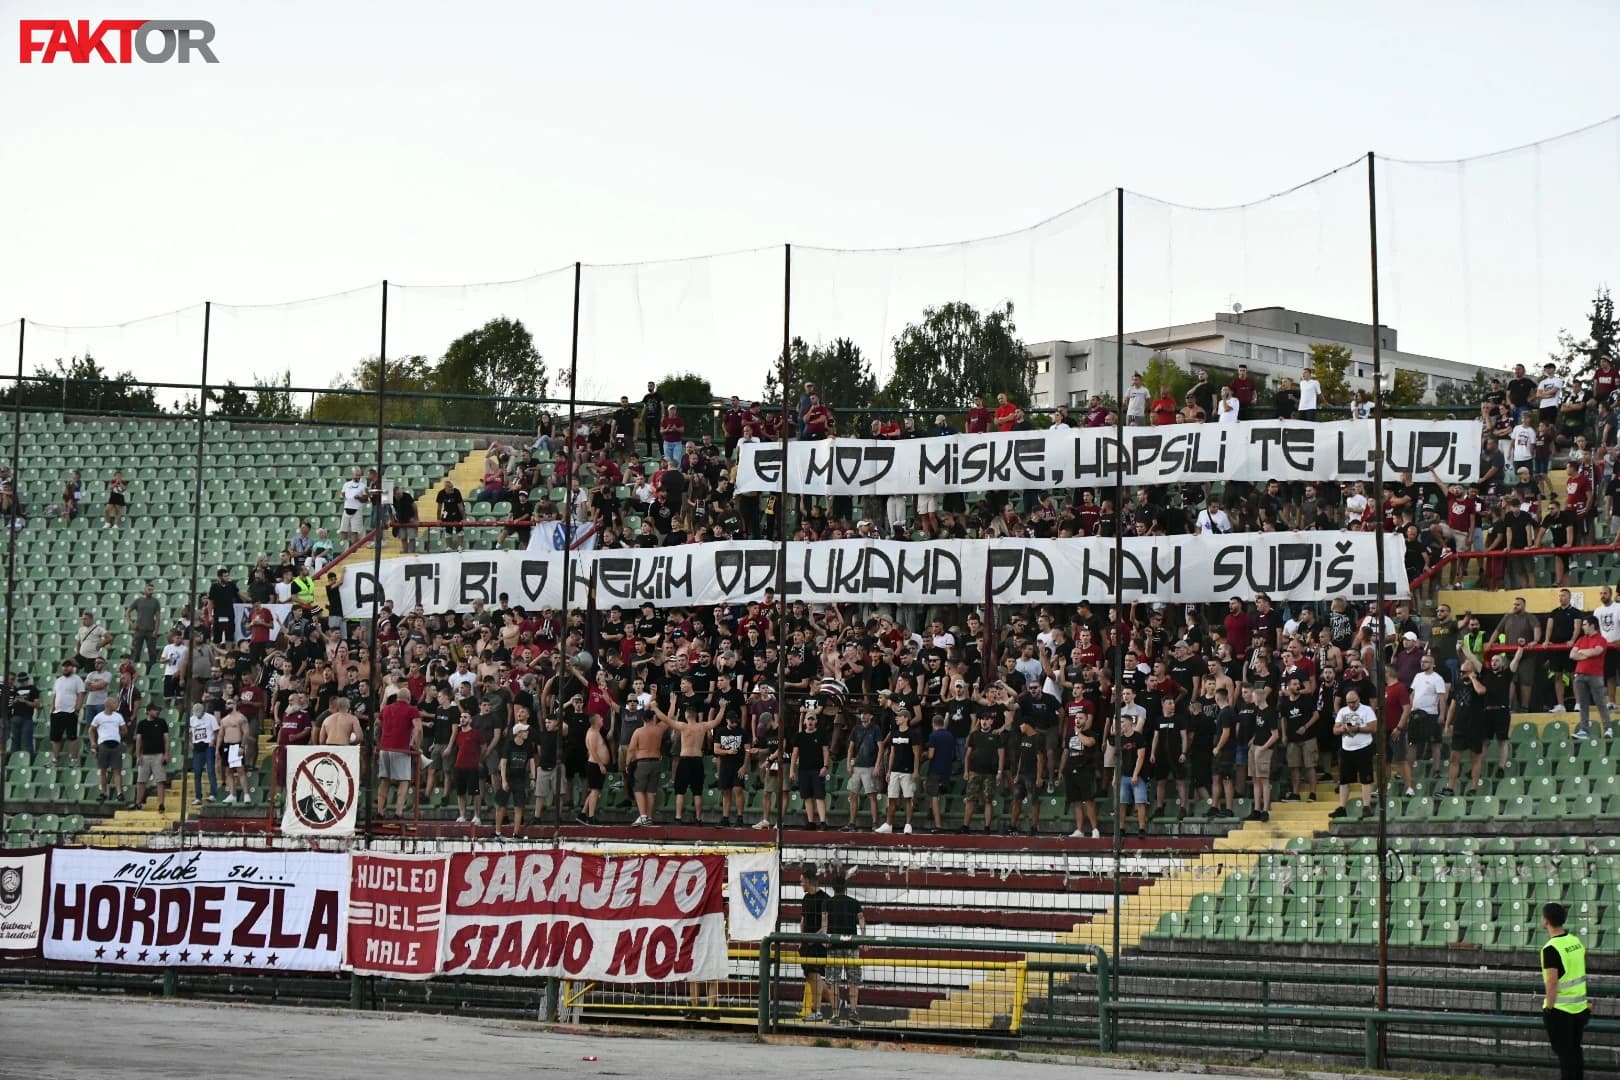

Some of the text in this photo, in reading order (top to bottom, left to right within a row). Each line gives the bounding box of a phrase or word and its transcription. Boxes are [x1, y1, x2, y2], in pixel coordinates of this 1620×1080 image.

[754, 449, 784, 482] E
[804, 446, 895, 486] MOJ
[1250, 428, 1314, 471] TE
[356, 572, 385, 608] A
[520, 560, 550, 602] O
[714, 546, 962, 597] ODLUKAMA
[987, 547, 1055, 596] DA
[1082, 546, 1181, 596] NAM
[357, 864, 437, 893] NUCLEO
[456, 854, 709, 914] SARAJEVO
[51, 883, 340, 951] HORDE ZLA
[374, 902, 415, 932] DEL
[365, 938, 421, 966] MALE
[443, 919, 702, 979] SIAMO NOI
